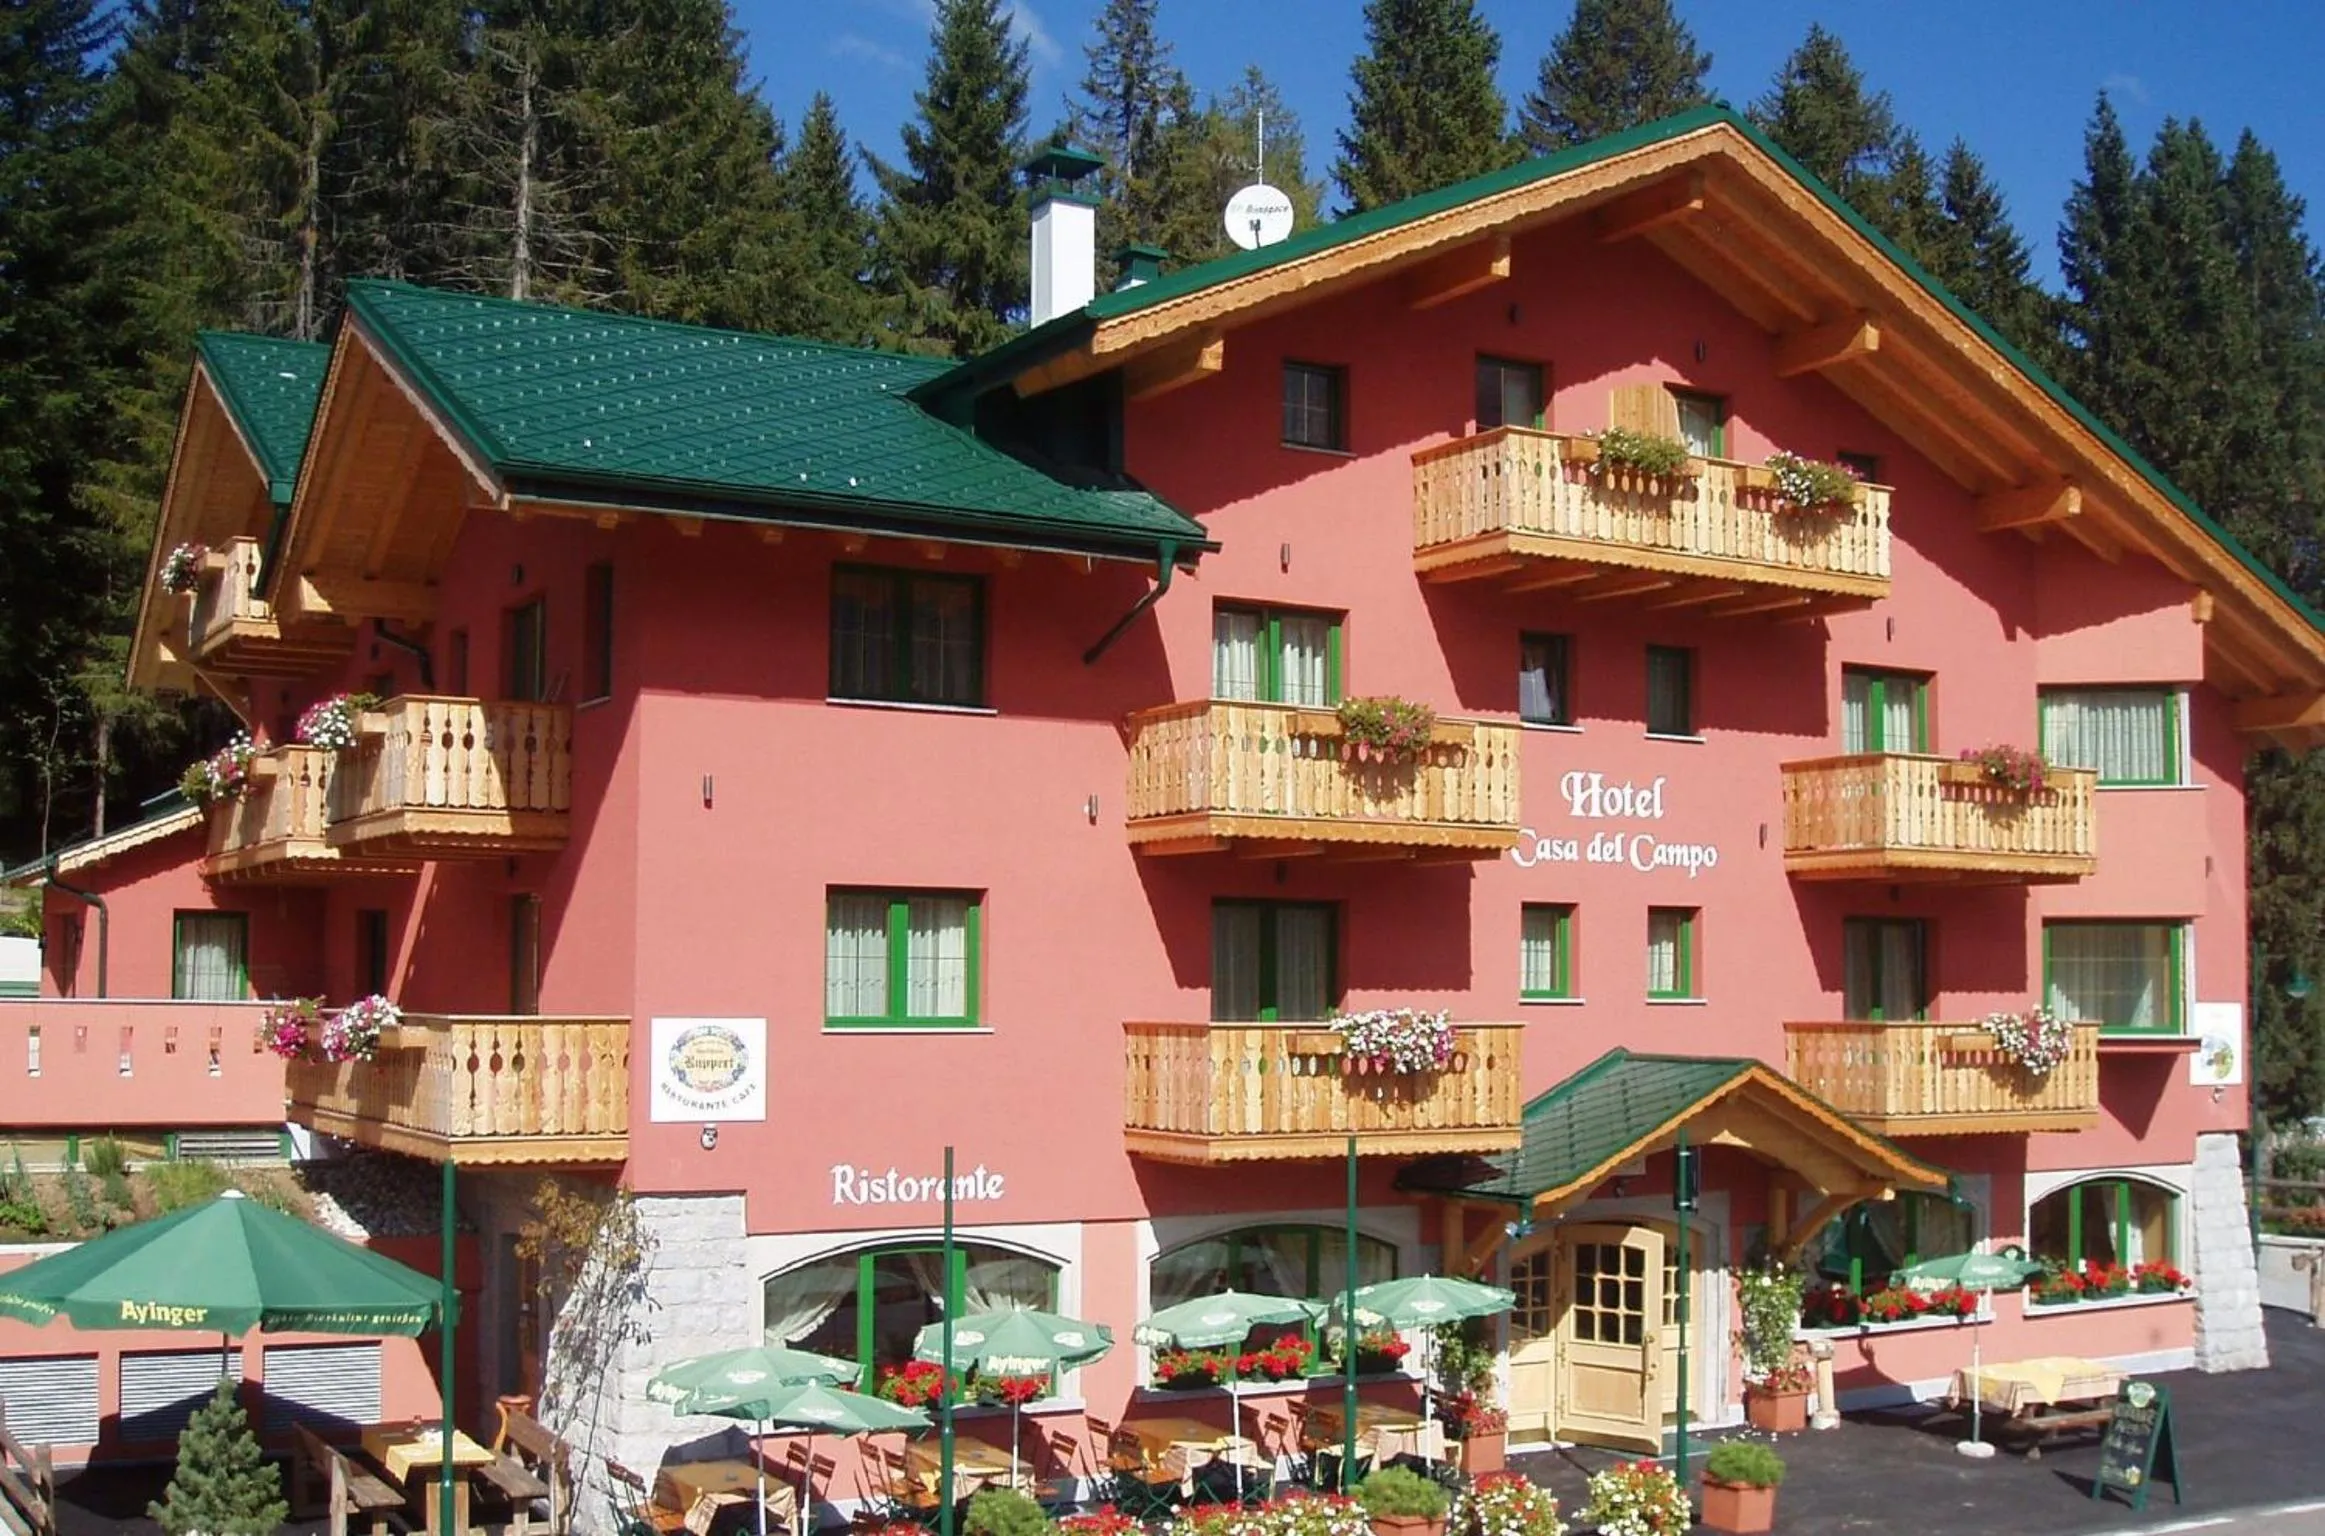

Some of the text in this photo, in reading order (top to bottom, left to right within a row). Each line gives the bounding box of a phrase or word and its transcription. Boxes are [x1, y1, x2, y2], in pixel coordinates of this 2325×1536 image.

[1560, 771, 1667, 819] Hotel
[1511, 828, 1718, 879] Casa del Campo
[830, 1164, 1005, 1205] Ristorante
[121, 1300, 208, 1326] Ayinger
[987, 1355, 1052, 1375] Ayinger
